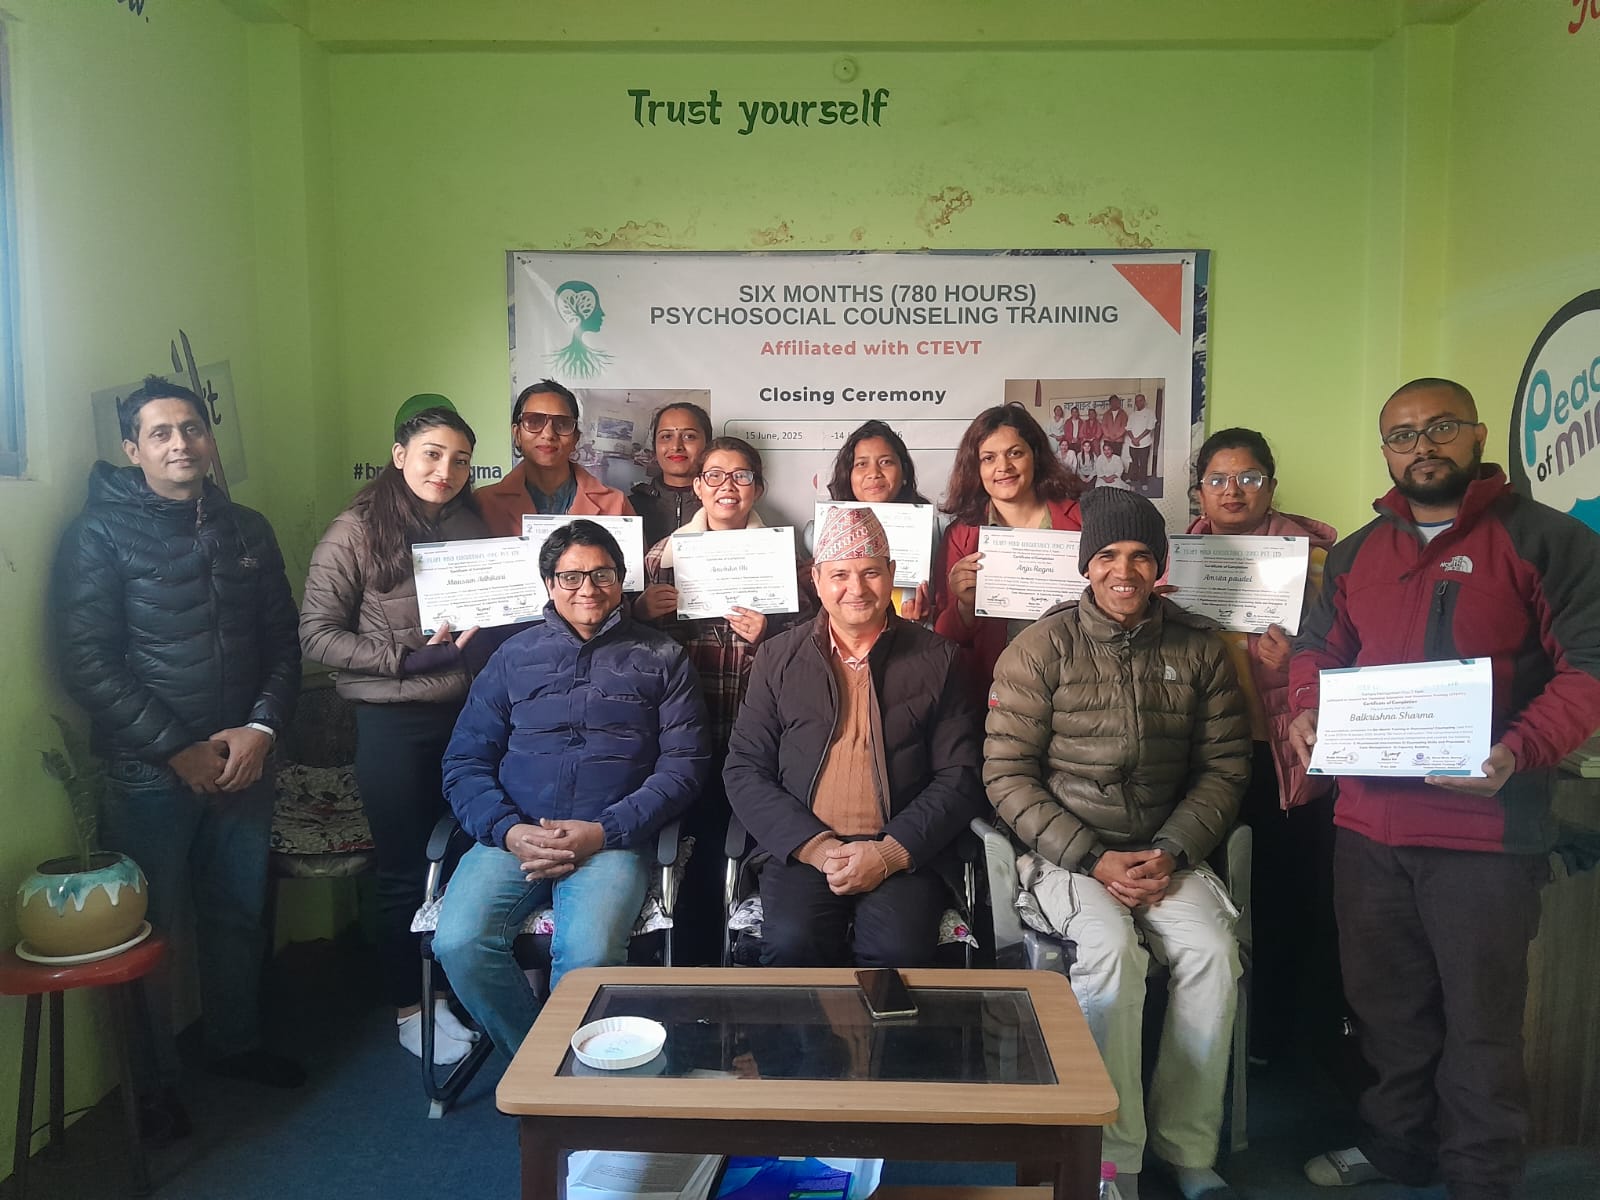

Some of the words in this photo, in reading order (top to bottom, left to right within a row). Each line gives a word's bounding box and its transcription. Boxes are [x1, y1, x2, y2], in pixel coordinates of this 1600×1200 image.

[627, 89, 723, 128] Trust
[738, 88, 890, 136] yourself
[739, 285, 777, 303] SIX
[783, 285, 884, 303] MONTHS
[891, 284, 937, 306] (780
[944, 284, 1037, 306] HOURS)
[650, 306, 836, 326] PSYCHOSOCIAL
[843, 306, 999, 325] COUNSELING
[1006, 305, 1119, 324] TRAINING
[760, 340, 857, 356] Affiliated
[864, 340, 909, 356] with
[916, 340, 983, 356] CTEVT
[759, 386, 836, 406] Closing
[842, 386, 947, 405] Ceremony
[745, 431, 756, 440] 15
[758, 431, 780, 441] June,
[782, 431, 803, 440] 2025
[1537, 444, 1553, 482] of
[1398, 711, 1435, 720] Sharma
